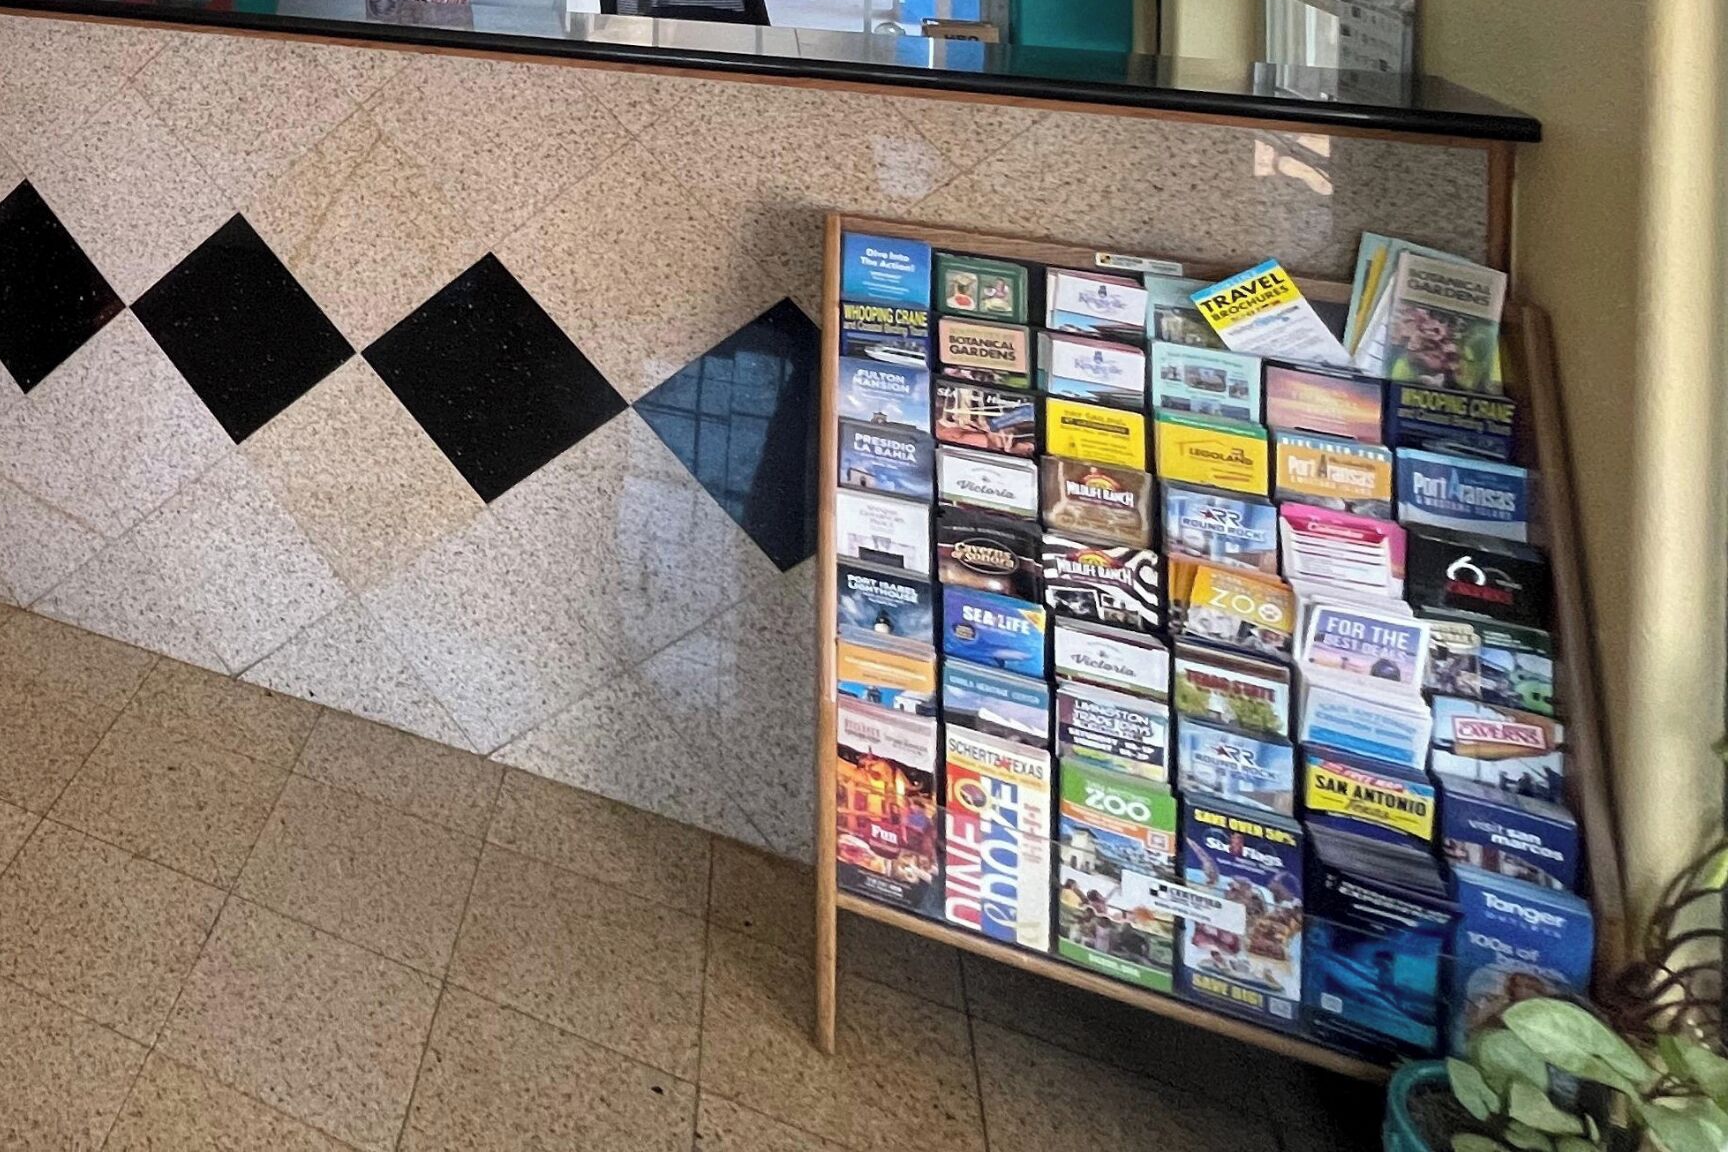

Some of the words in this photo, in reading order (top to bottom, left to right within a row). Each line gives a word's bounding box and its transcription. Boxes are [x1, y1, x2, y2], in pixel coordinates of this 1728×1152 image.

[1199, 271, 1286, 314] TRAVEL
[1211, 284, 1290, 322] BROCHURES
[843, 303, 894, 325] WHOOPING
[895, 309, 928, 328] CRANE
[949, 335, 1014, 351] BOTANICAL
[949, 344, 1017, 362] GARDENS
[852, 376, 910, 394] MANSION
[856, 368, 905, 385] FULTON
[853, 440, 872, 454] LA
[874, 445, 917, 464] BAHIA
[854, 431, 917, 454] PRESIDIO
[1188, 447, 1254, 467] LEGOLAND
[955, 478, 1016, 500] Victoria
[1181, 517, 1225, 533] ROUND
[1226, 526, 1263, 540] ROCK
[962, 605, 996, 625] SEA
[996, 613, 1032, 636] LIFE
[1326, 615, 1366, 640] FOR
[1367, 625, 1411, 650] THE
[1322, 632, 1360, 652] BEST
[1360, 640, 1409, 662] DEALS
[1070, 652, 1137, 678] Victoria
[1457, 721, 1542, 746] CAVERNS
[1004, 758, 1044, 781] TEXAS
[1083, 787, 1152, 822] ZOO
[1314, 774, 1349, 797] SAN
[1353, 784, 1427, 818] ANTONIO
[871, 824, 899, 846] Fun
[1193, 808, 1227, 827] SAVE
[1229, 816, 1263, 837] OVER
[1490, 833, 1566, 863] marcos
[1504, 827, 1543, 846] san
[945, 813, 983, 931] DINE
[1481, 890, 1569, 929] Tanger
